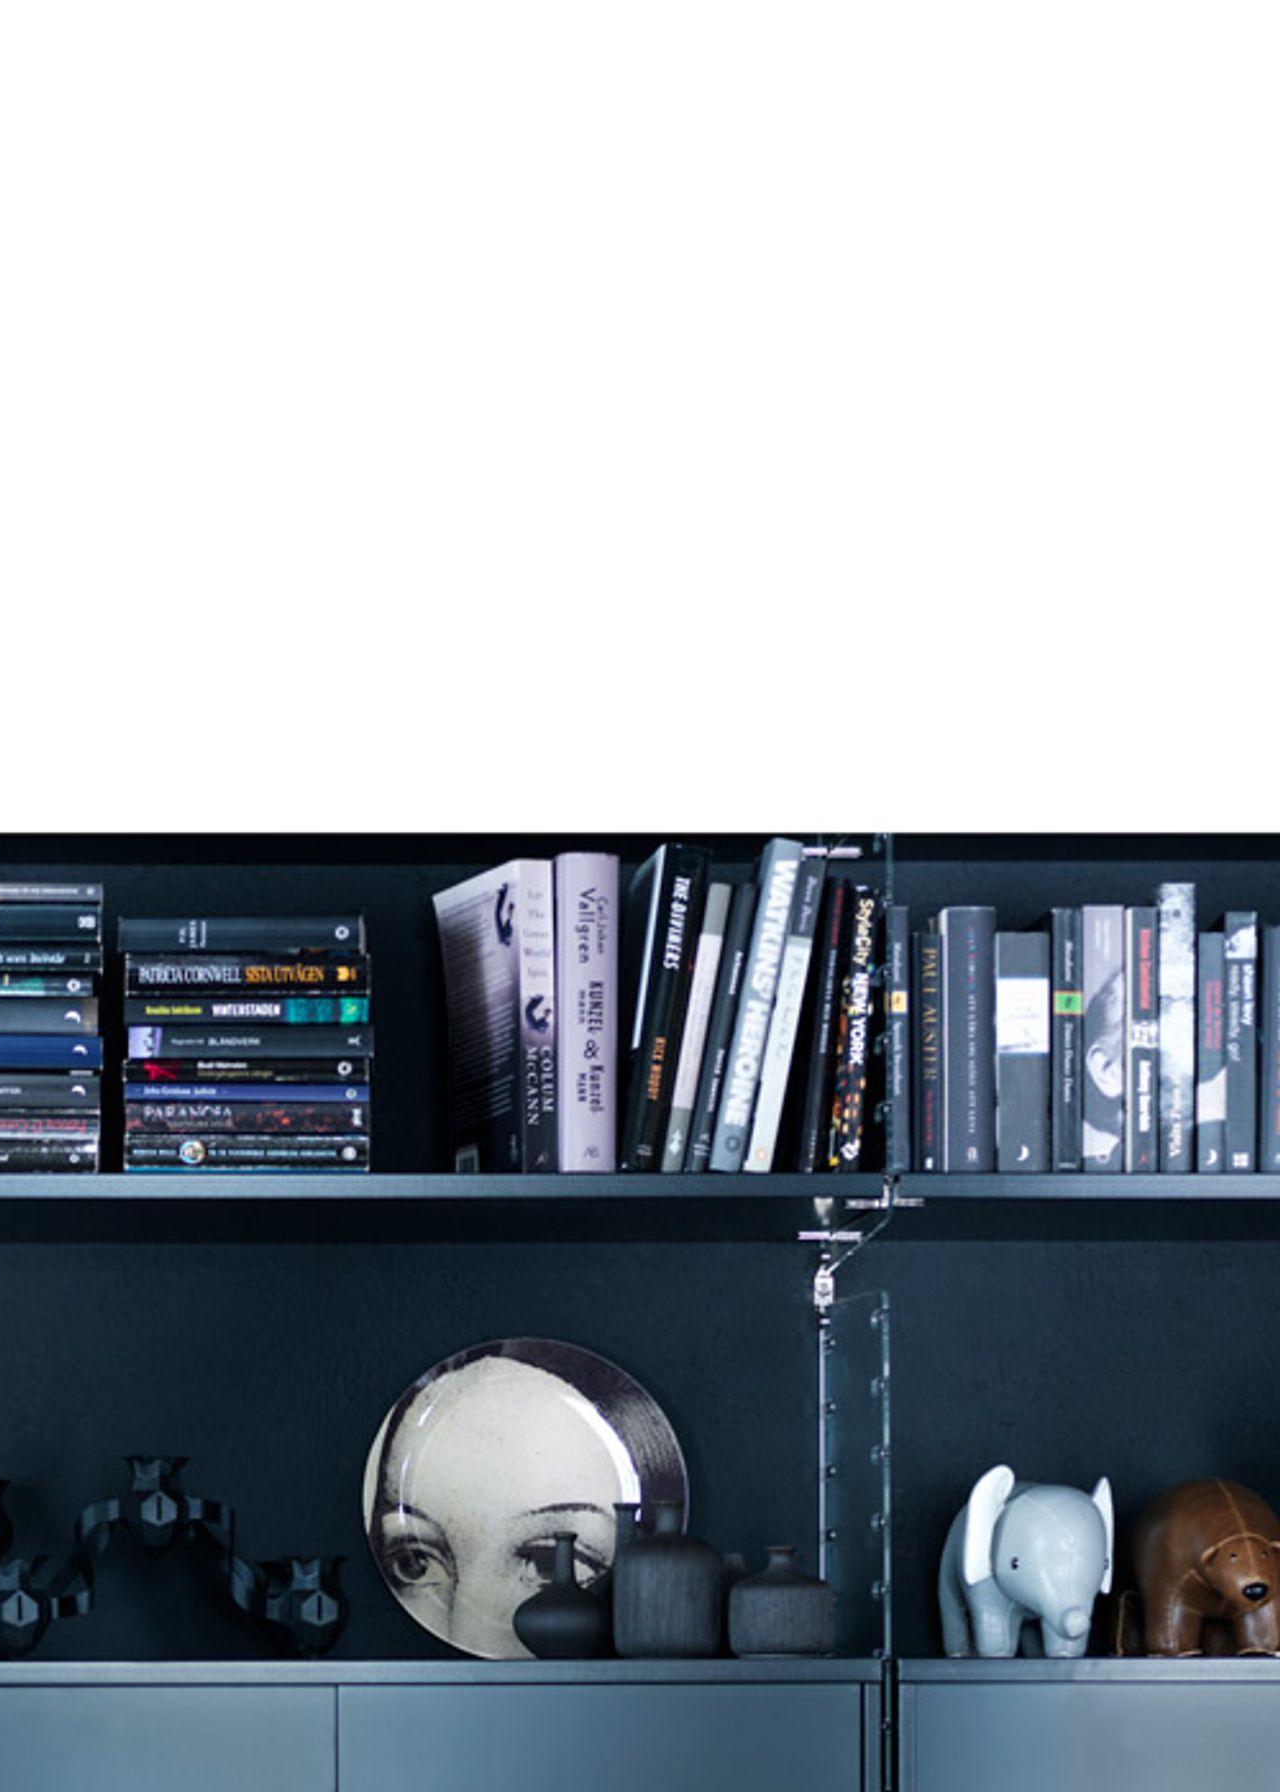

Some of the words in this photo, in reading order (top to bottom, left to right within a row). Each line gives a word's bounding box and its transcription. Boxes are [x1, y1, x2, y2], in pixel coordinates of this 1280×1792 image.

[672, 876, 691, 902] THE
[576, 887, 597, 964] Vallgren
[662, 902, 688, 970] DIVINERS
[853, 897, 875, 966] StyleCity
[138, 964, 184, 984] PATRICIA
[185, 965, 242, 984] CORNWELL
[244, 964, 272, 984] SISTA
[850, 972, 870, 1016] NEW
[923, 946, 938, 993] PAUL
[584, 1040, 600, 1060] &
[723, 1000, 768, 1127] HEROINE
[848, 1016, 869, 1067] YORK
[921, 1004, 937, 1082] AUSTER
[541, 1046, 555, 1113] COLUM
[143, 1105, 233, 1119] PARANOIA
